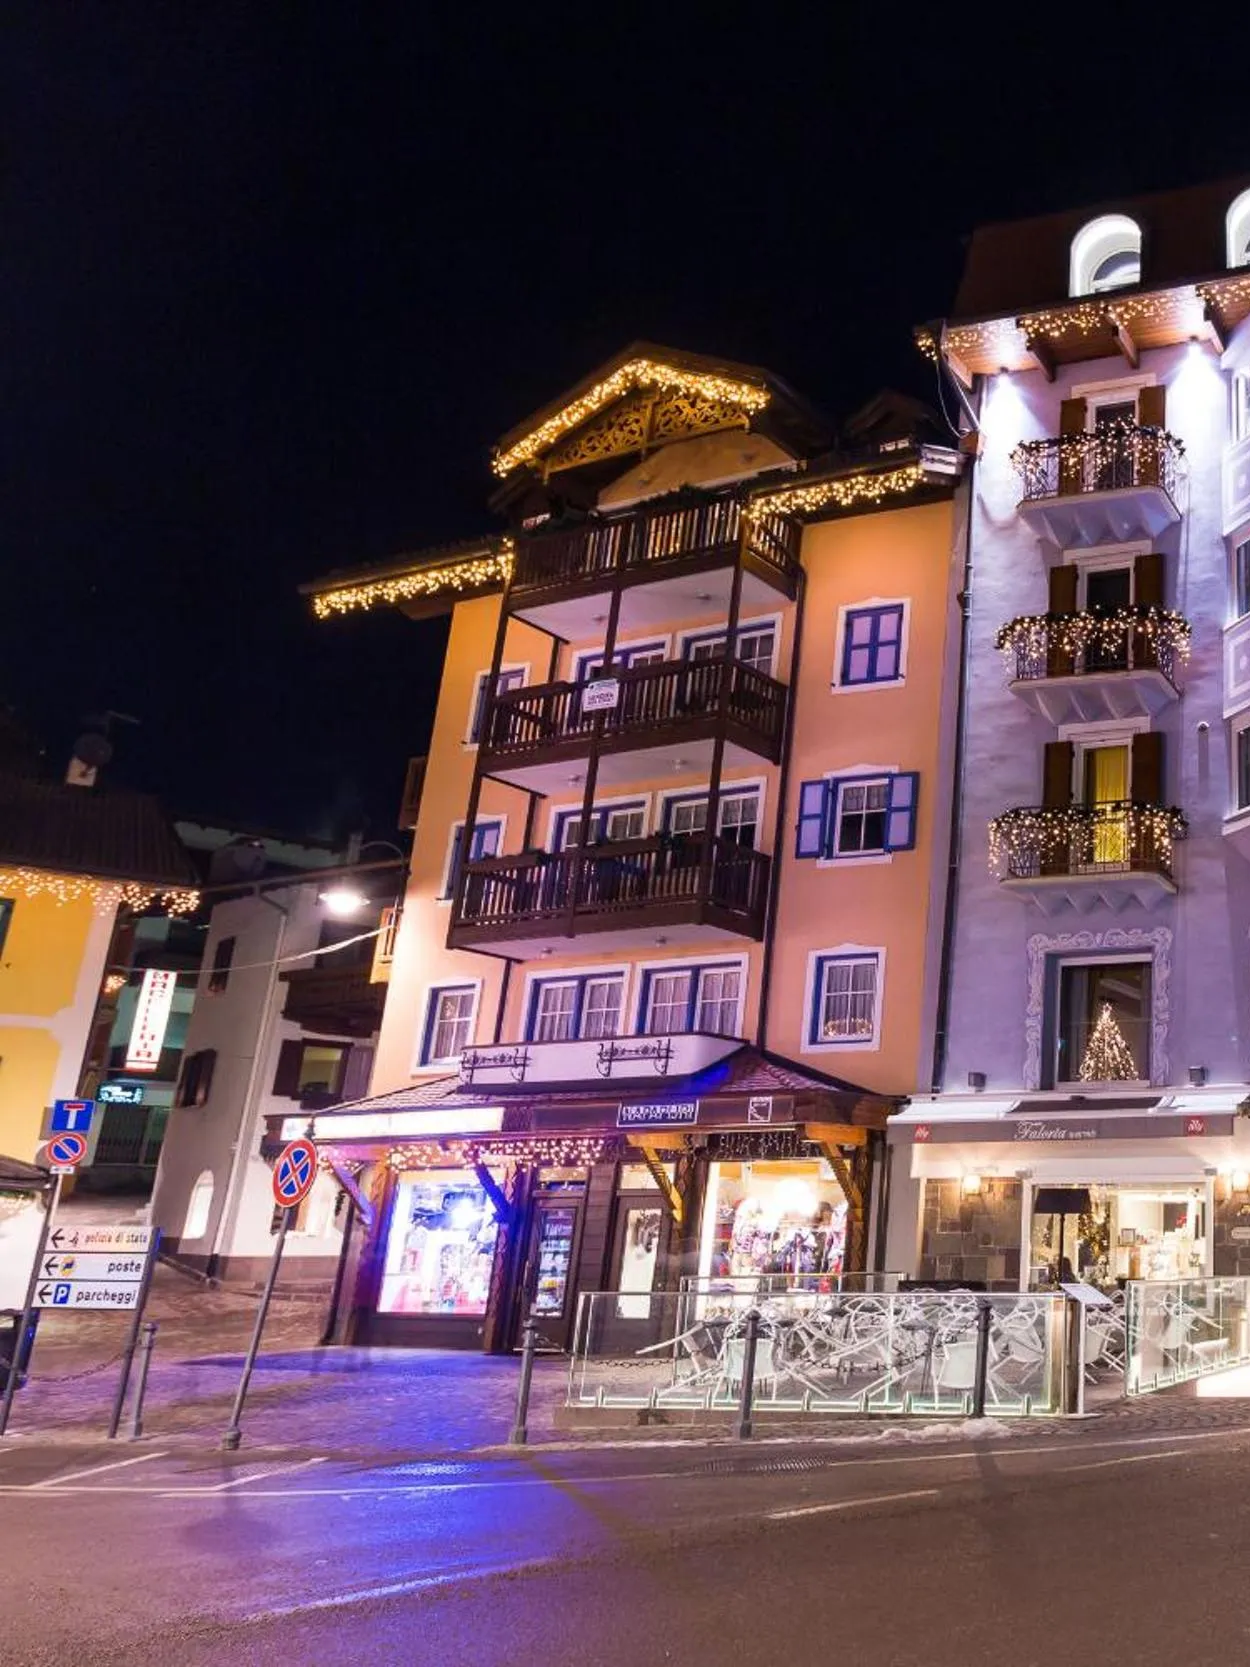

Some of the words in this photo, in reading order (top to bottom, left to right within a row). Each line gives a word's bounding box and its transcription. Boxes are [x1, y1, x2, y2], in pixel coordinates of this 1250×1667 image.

[1013, 1121, 1067, 1140] Faloria
[107, 1260, 142, 1273] poste
[75, 1289, 137, 1305] parcheggi
